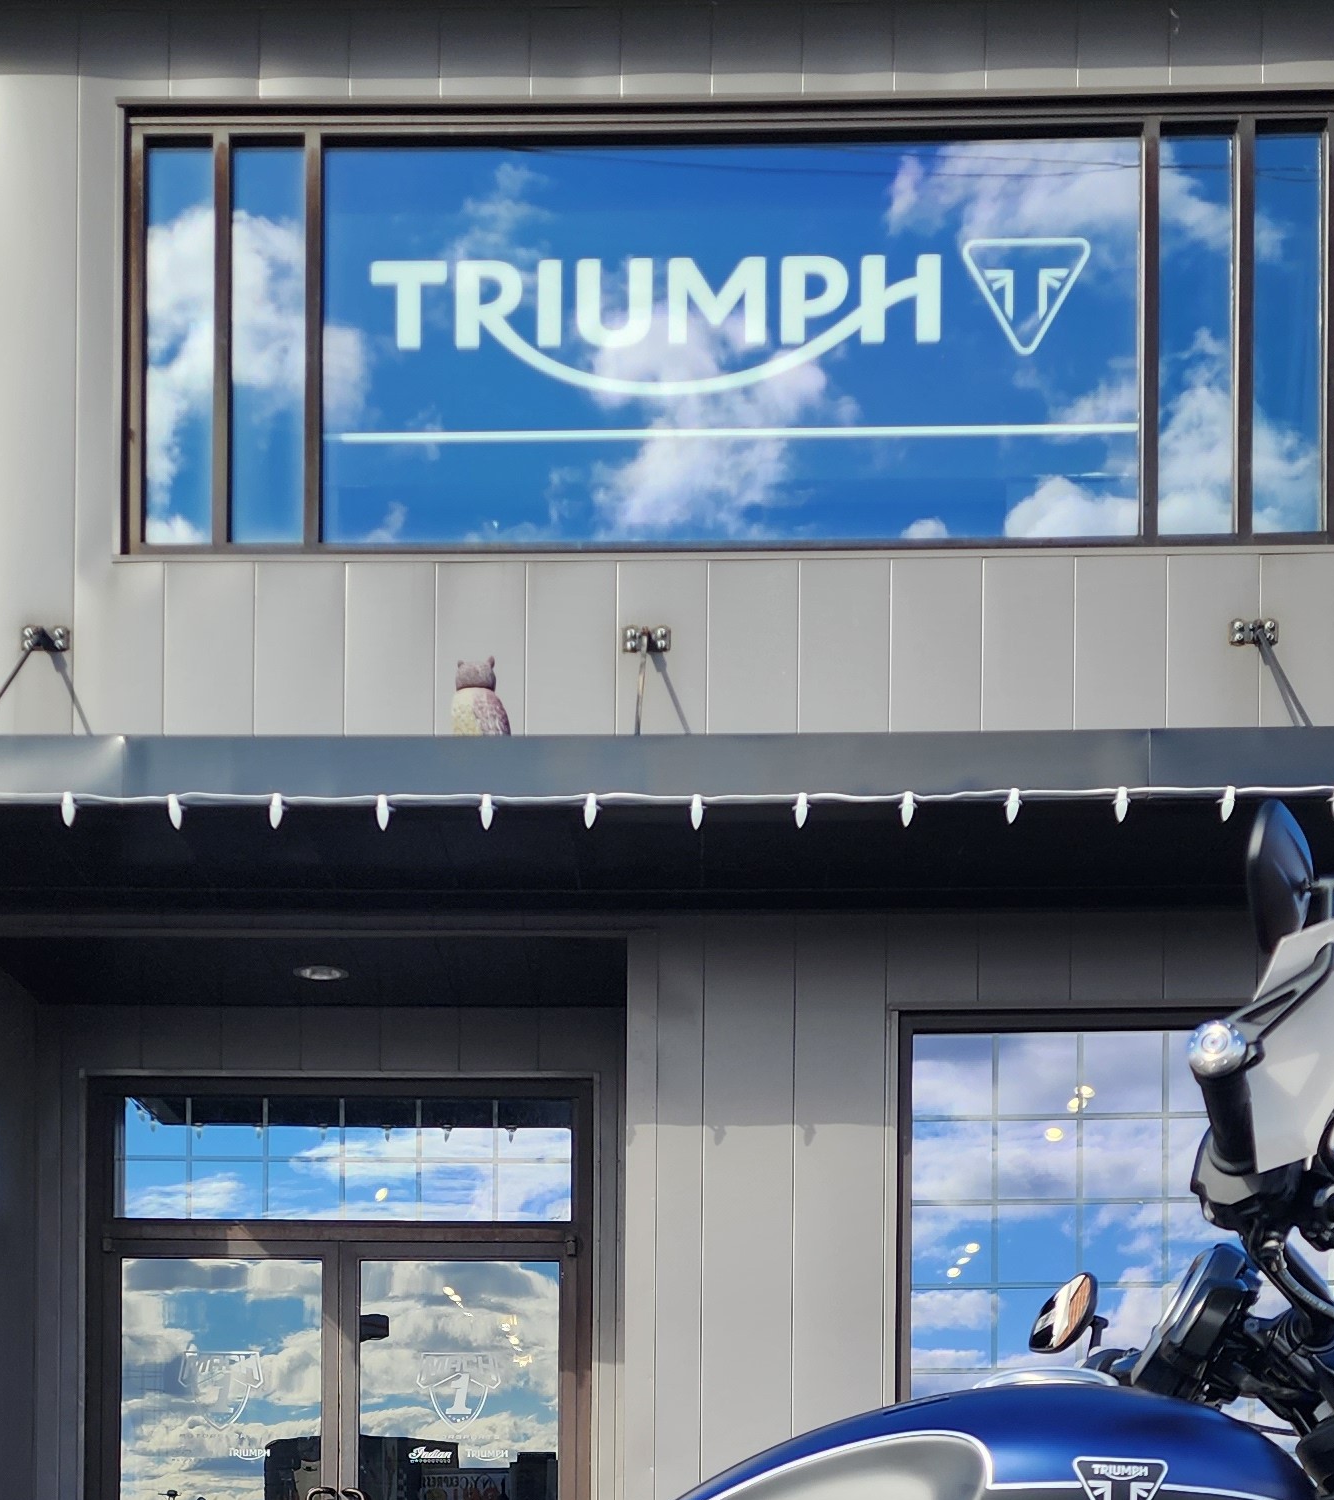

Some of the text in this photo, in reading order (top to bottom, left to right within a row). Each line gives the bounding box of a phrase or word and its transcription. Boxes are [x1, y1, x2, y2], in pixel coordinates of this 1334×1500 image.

[370, 253, 942, 396] TRIUMPH
[445, 1373, 472, 1414] 1
[229, 1448, 271, 1460] TRIUMPH
[408, 1446, 453, 1459] Indian
[466, 1449, 509, 1461] TRIUMPH
[1091, 1463, 1149, 1480] TRIUMPH
